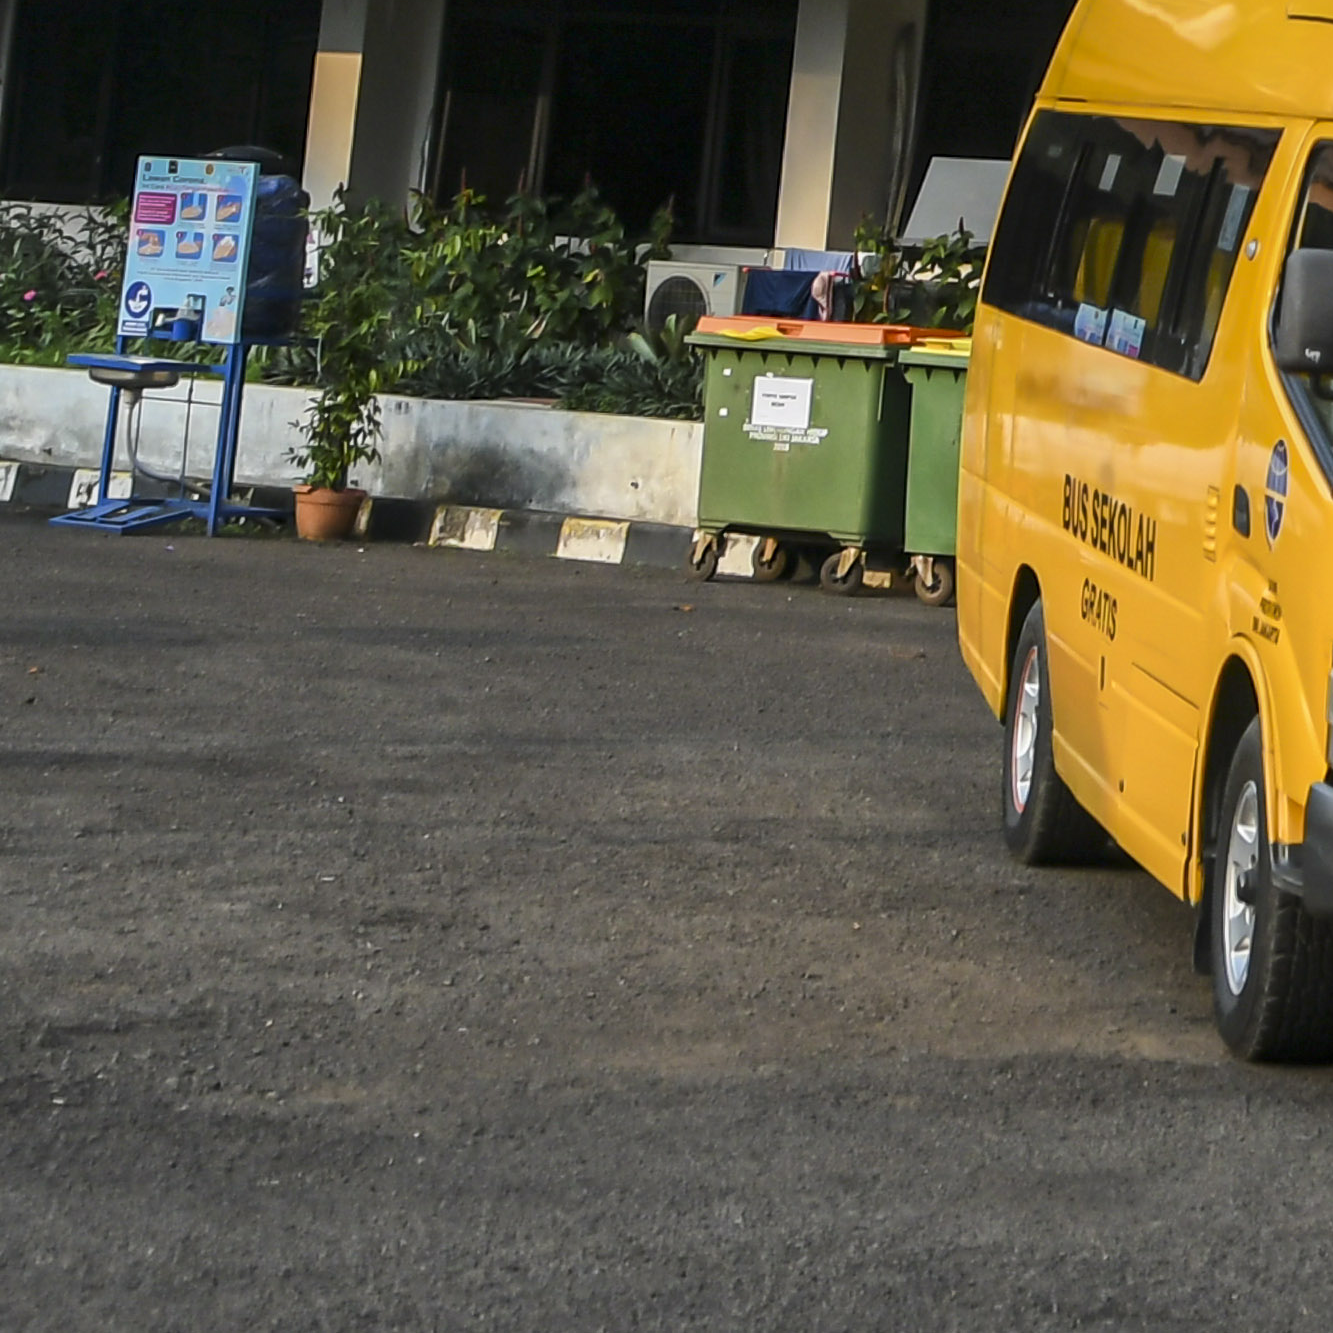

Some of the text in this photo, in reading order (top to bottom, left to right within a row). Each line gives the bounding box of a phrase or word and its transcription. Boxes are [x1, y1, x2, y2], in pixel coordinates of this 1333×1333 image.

[1063, 474, 1156, 582] BUS SEKOLAH
[1081, 577, 1118, 641] GRATIS
